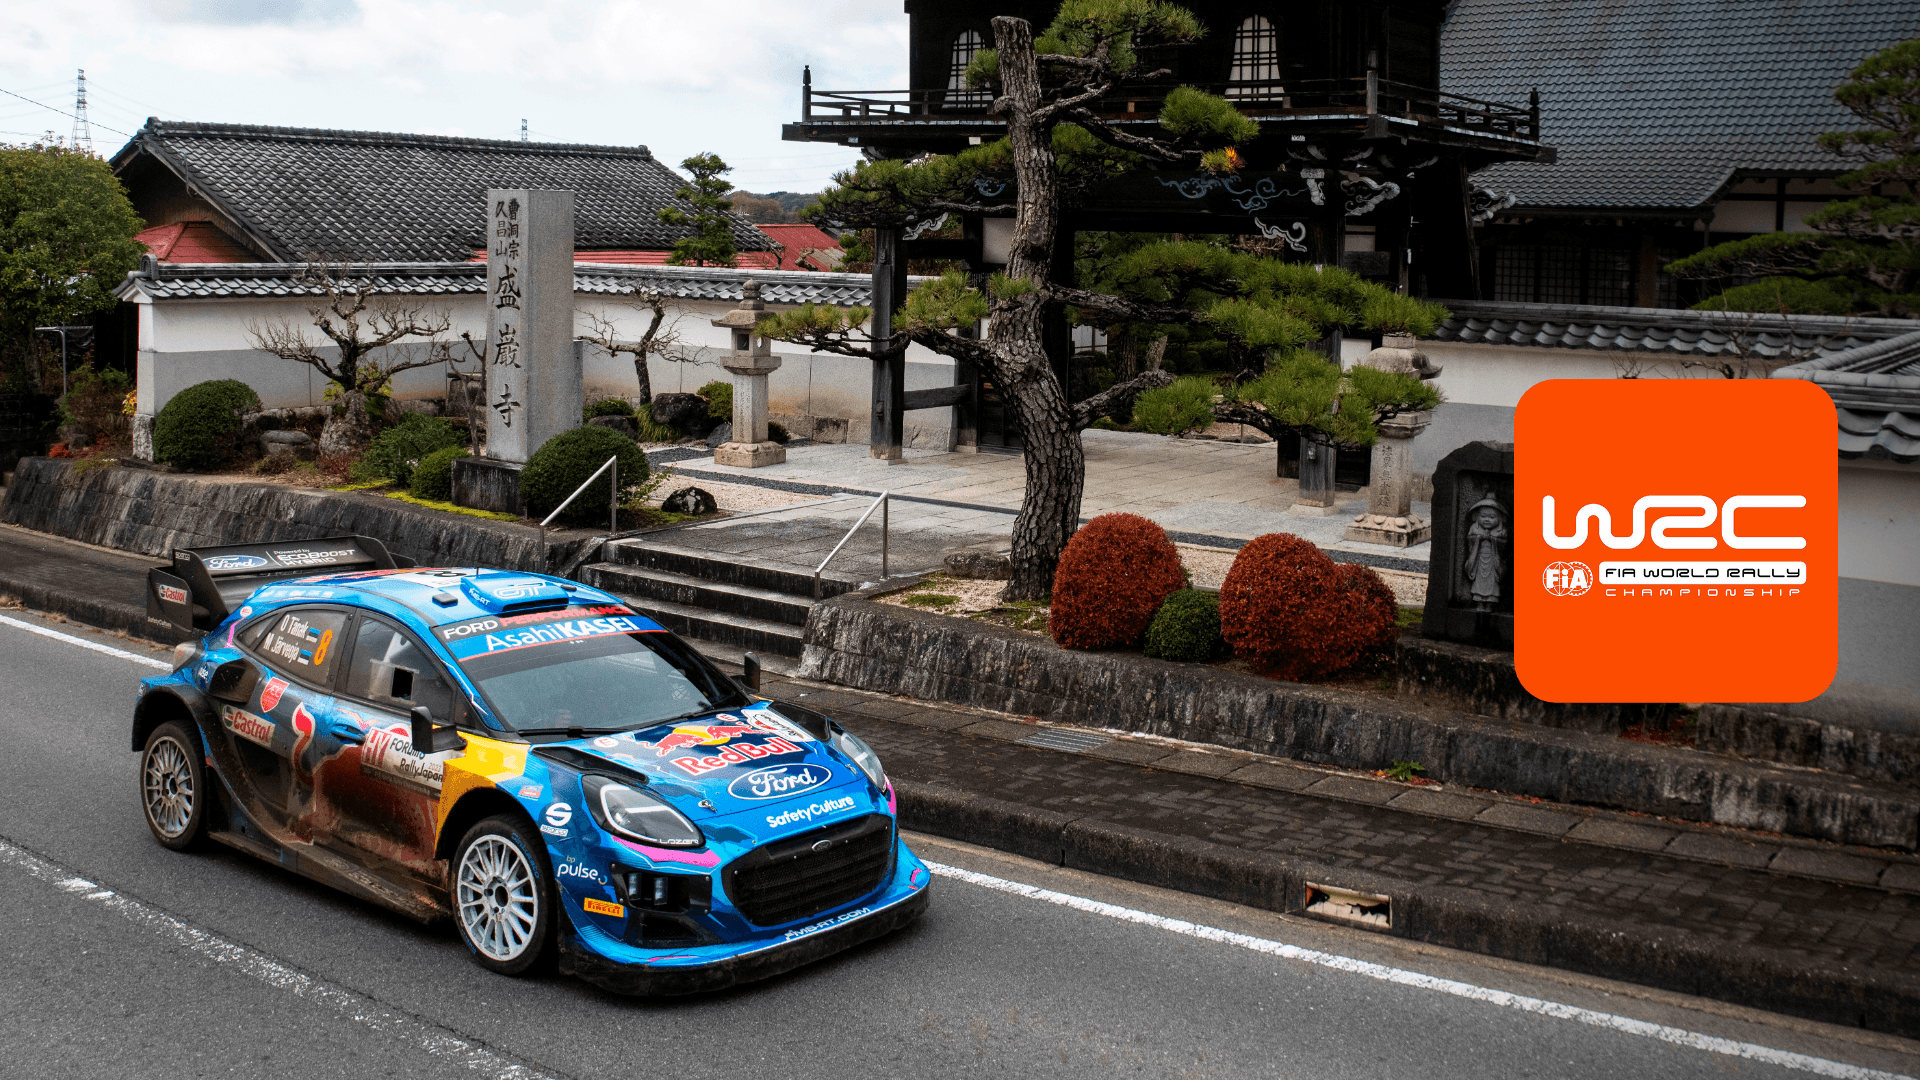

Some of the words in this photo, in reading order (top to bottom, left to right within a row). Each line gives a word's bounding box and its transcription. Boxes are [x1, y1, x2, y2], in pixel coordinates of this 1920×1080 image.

[495, 200, 508, 257] 久昌山
[508, 198, 520, 260] 曹洞宗
[283, 557, 337, 566] HYBRID
[165, 588, 185, 602] Castrol
[280, 614, 290, 631] O
[443, 620, 498, 639] FORD
[500, 606, 634, 627] PERFORMANCE
[263, 632, 275, 650] M
[314, 629, 333, 666] 8
[233, 711, 271, 743] Castrol
[669, 745, 752, 776] Red
[729, 736, 804, 760] Bull
[748, 767, 818, 796] Ford
[766, 797, 855, 828] SafetyCulture
[557, 862, 598, 880] pulse
[566, 855, 575, 863] bp
[587, 900, 621, 915] PIRELLI
